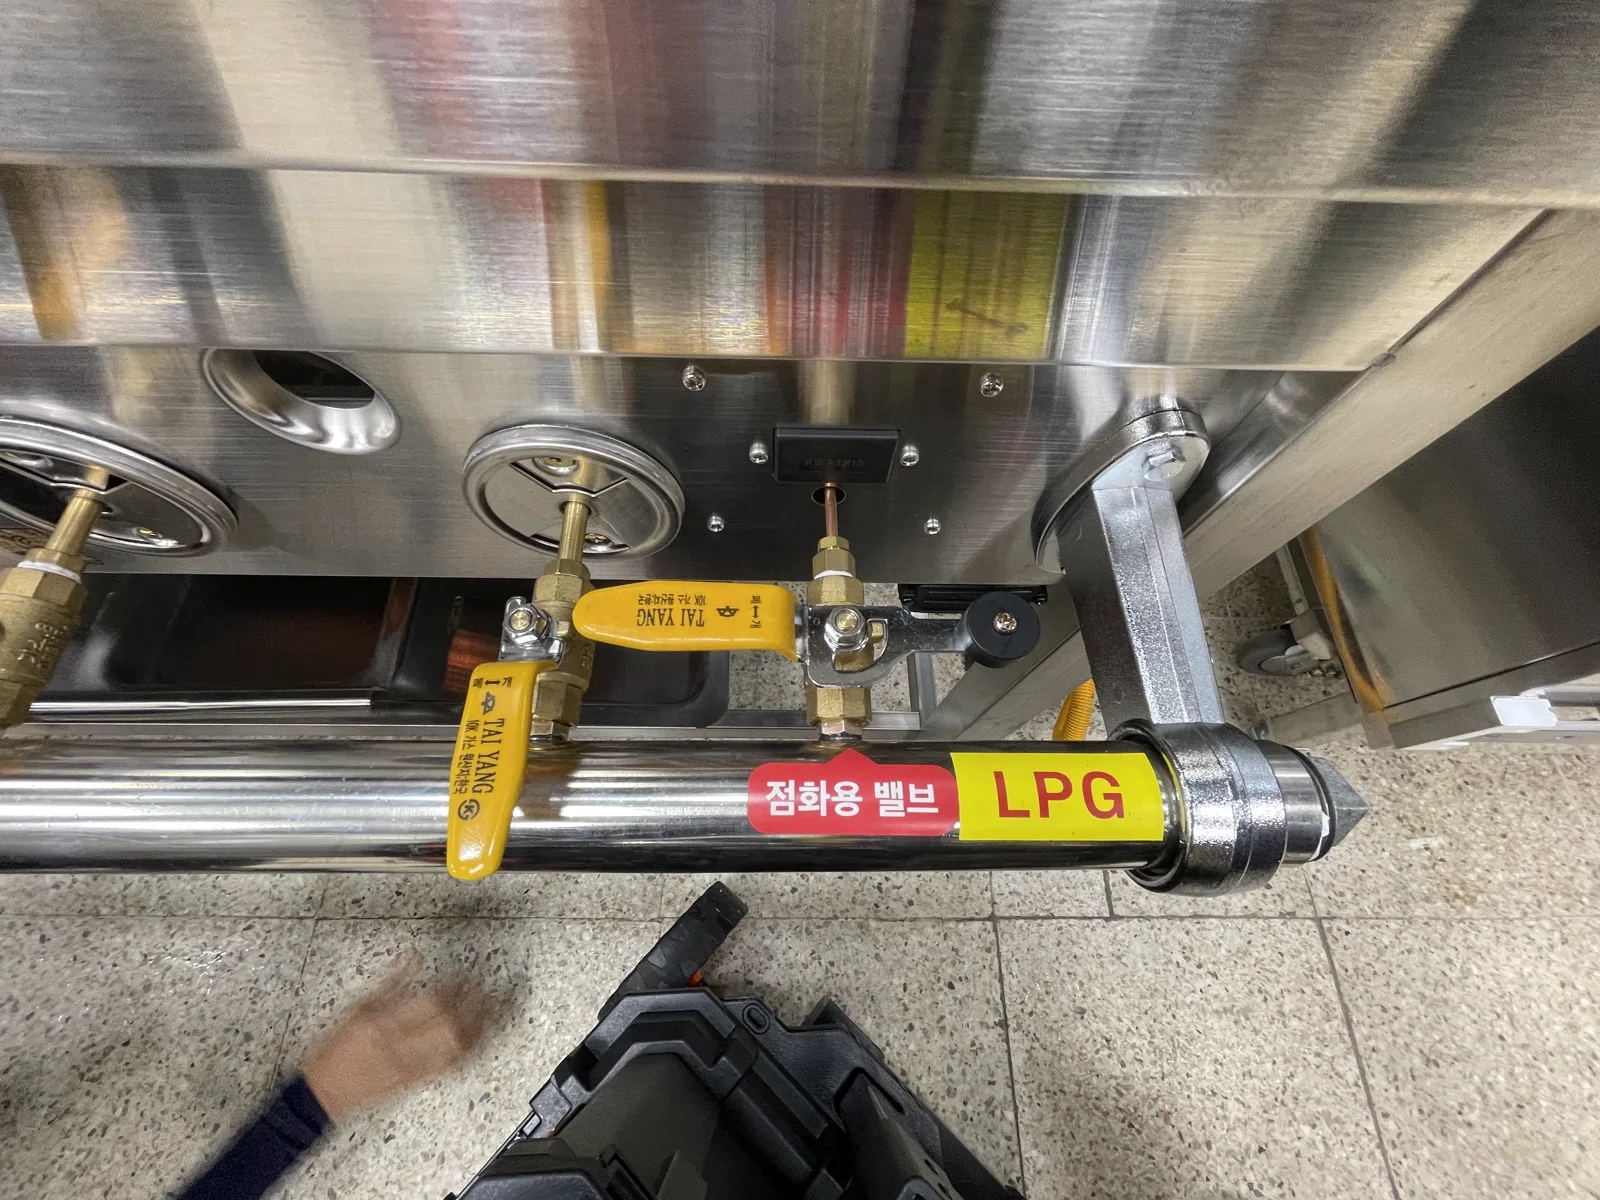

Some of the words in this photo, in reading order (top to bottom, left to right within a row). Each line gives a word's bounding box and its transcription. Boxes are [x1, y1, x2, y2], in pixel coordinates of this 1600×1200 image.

[678, 594, 691, 605] 가스
[694, 594, 706, 606] 10K
[637, 608, 675, 627] YANG
[680, 609, 705, 627] TAI
[749, 620, 762, 629] 개
[502, 676, 513, 688] 개
[465, 720, 480, 732] 10K
[481, 718, 505, 744] TAI
[462, 735, 477, 750] 가스
[452, 753, 475, 794] 원산지:한국
[472, 750, 500, 794] YANG
[765, 780, 863, 817] 점화용
[874, 781, 939, 817] 밸브
[993, 771, 1125, 819] LPG
